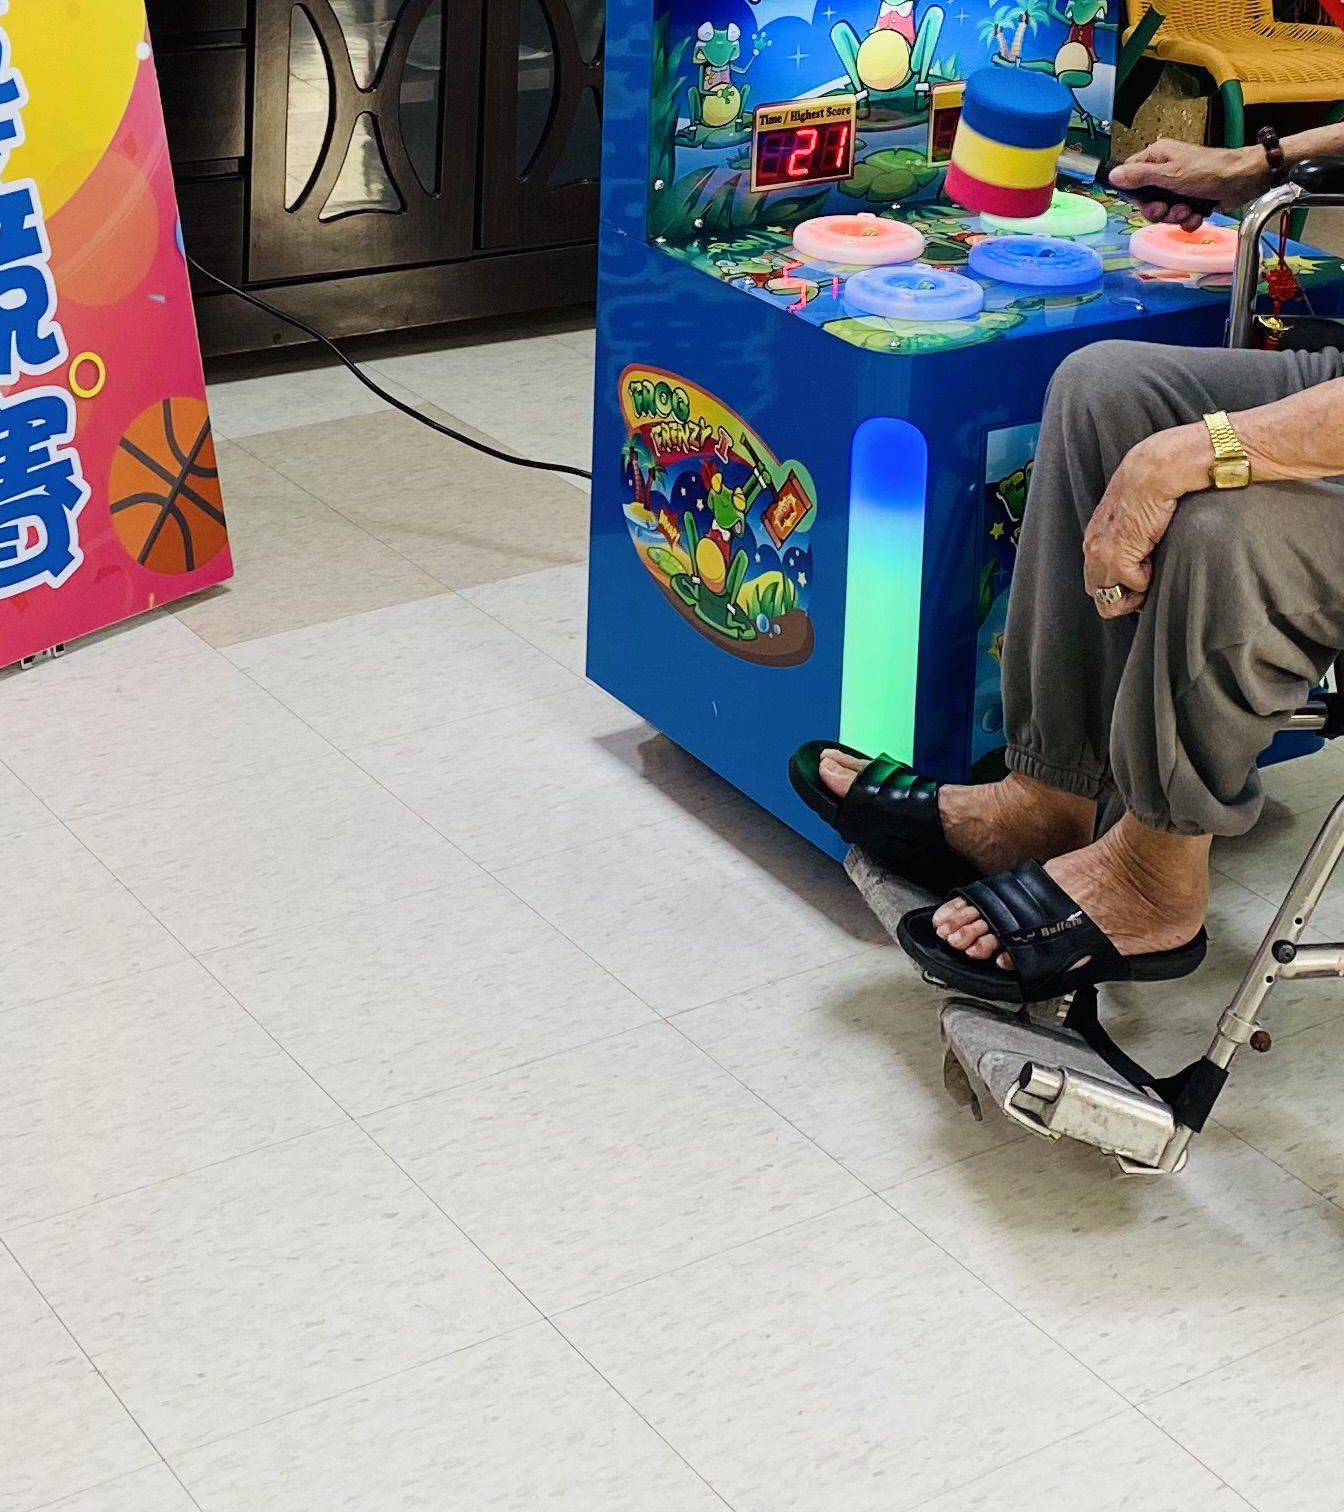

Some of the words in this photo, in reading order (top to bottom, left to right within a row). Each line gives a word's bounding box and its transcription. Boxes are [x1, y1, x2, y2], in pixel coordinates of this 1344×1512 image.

[759, 113, 782, 126] Time
[790, 107, 824, 122] Highest
[826, 105, 851, 118] Score
[788, 126, 848, 176] 21
[629, 379, 690, 424] FROG
[650, 417, 712, 457] FRENZY
